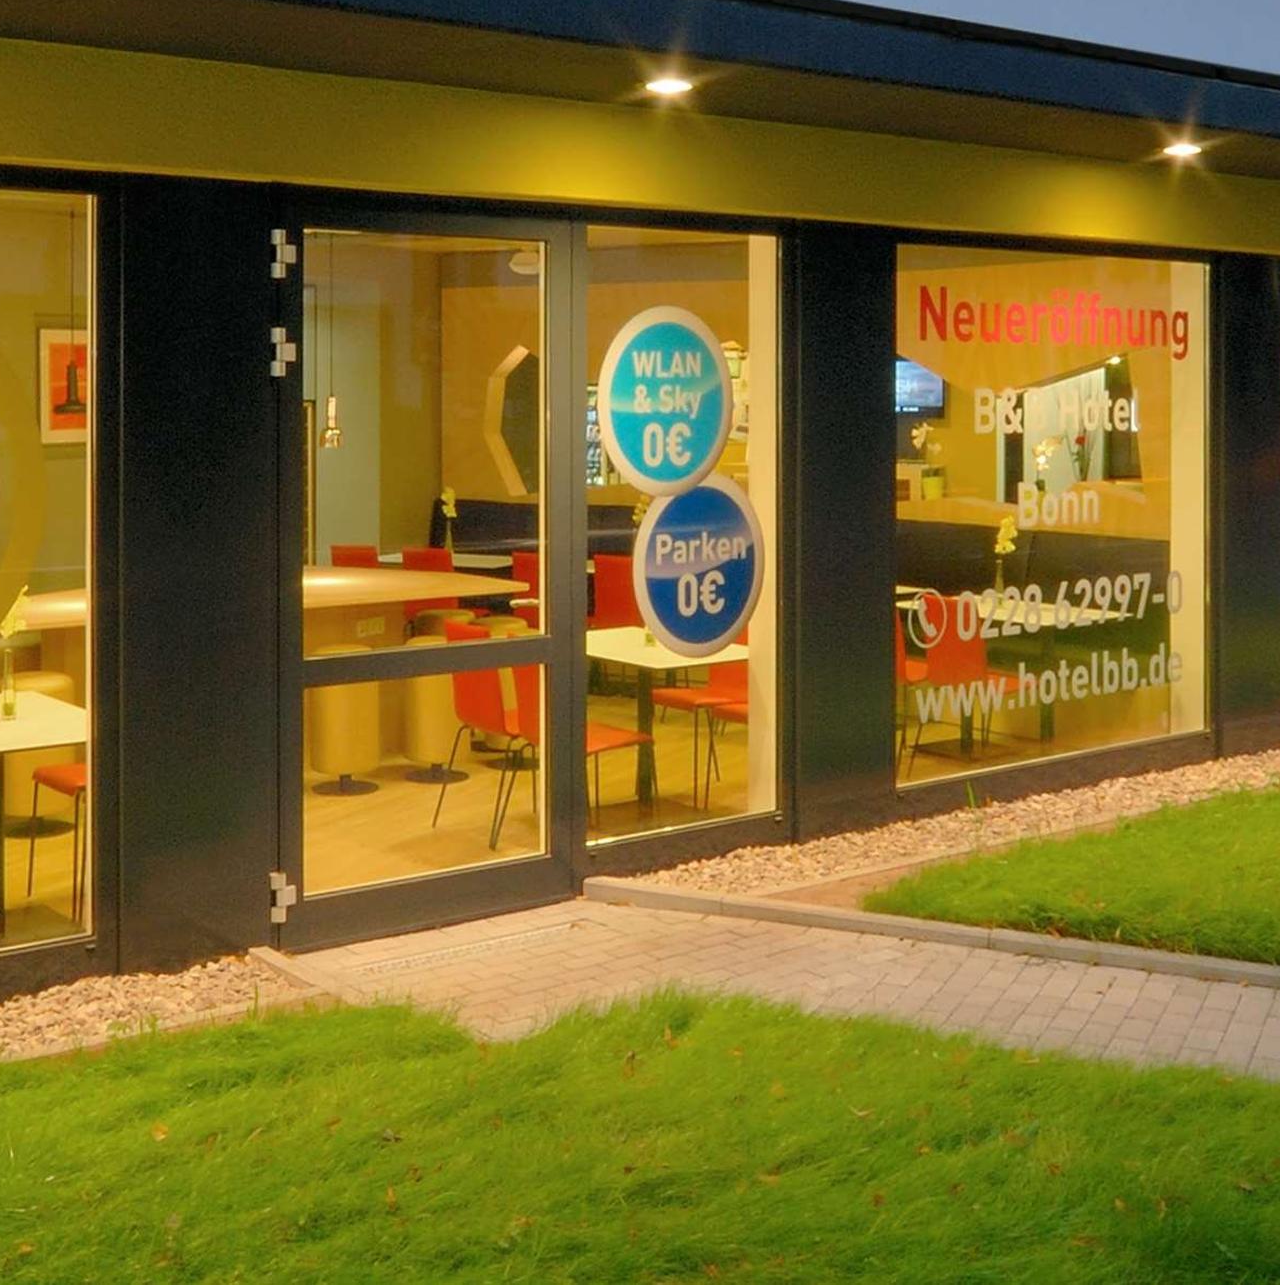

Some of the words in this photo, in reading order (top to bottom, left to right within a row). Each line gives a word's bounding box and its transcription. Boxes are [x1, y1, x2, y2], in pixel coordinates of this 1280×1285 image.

[919, 285, 1189, 361] Neueröffnung
[632, 350, 702, 379] WLAN
[634, 384, 652, 413] &
[659, 384, 702, 420] Sky
[1057, 387, 1141, 433] Hotel
[643, 422, 692, 468] 0€
[1018, 481, 1101, 530] Bonn
[655, 530, 748, 567] Parken
[677, 569, 726, 618] 0€
[956, 583, 1043, 642] 0228
[1054, 570, 1183, 631] 62997-0
[914, 642, 1183, 724] www.hotelbb.de
